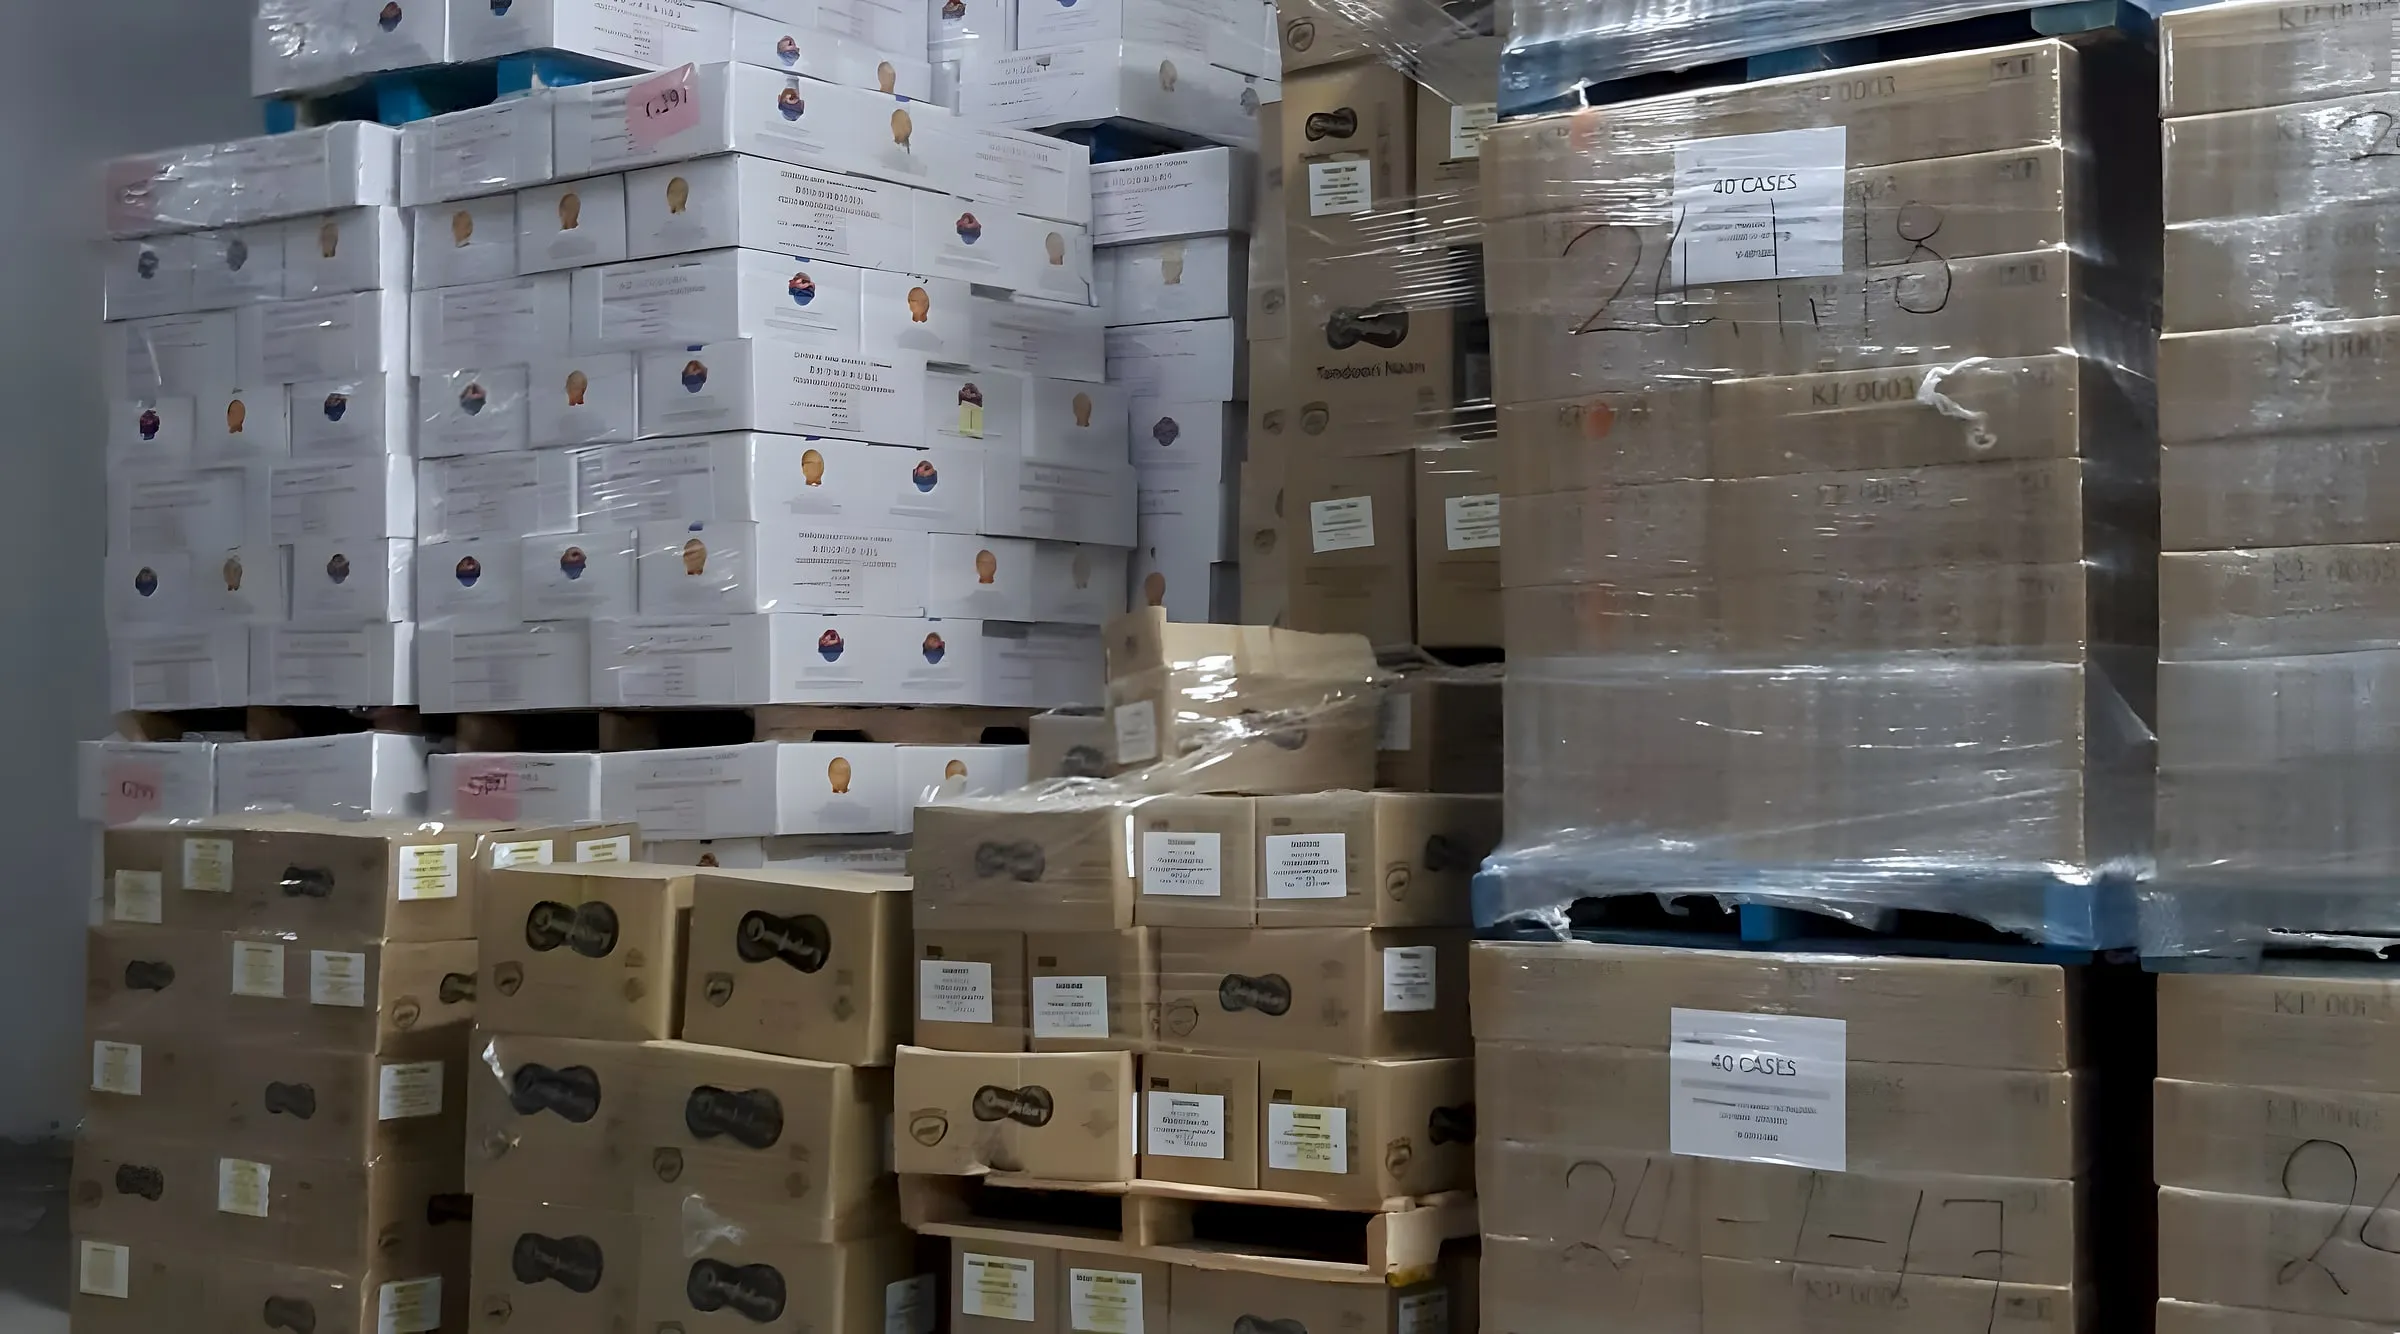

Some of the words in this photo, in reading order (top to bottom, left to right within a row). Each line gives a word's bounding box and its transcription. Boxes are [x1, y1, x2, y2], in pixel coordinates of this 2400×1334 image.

[1713, 178, 1736, 195] 40
[1741, 173, 1797, 193] CASES
[1711, 1053, 1734, 1072] 40
[1739, 1055, 1796, 1076] CASES
